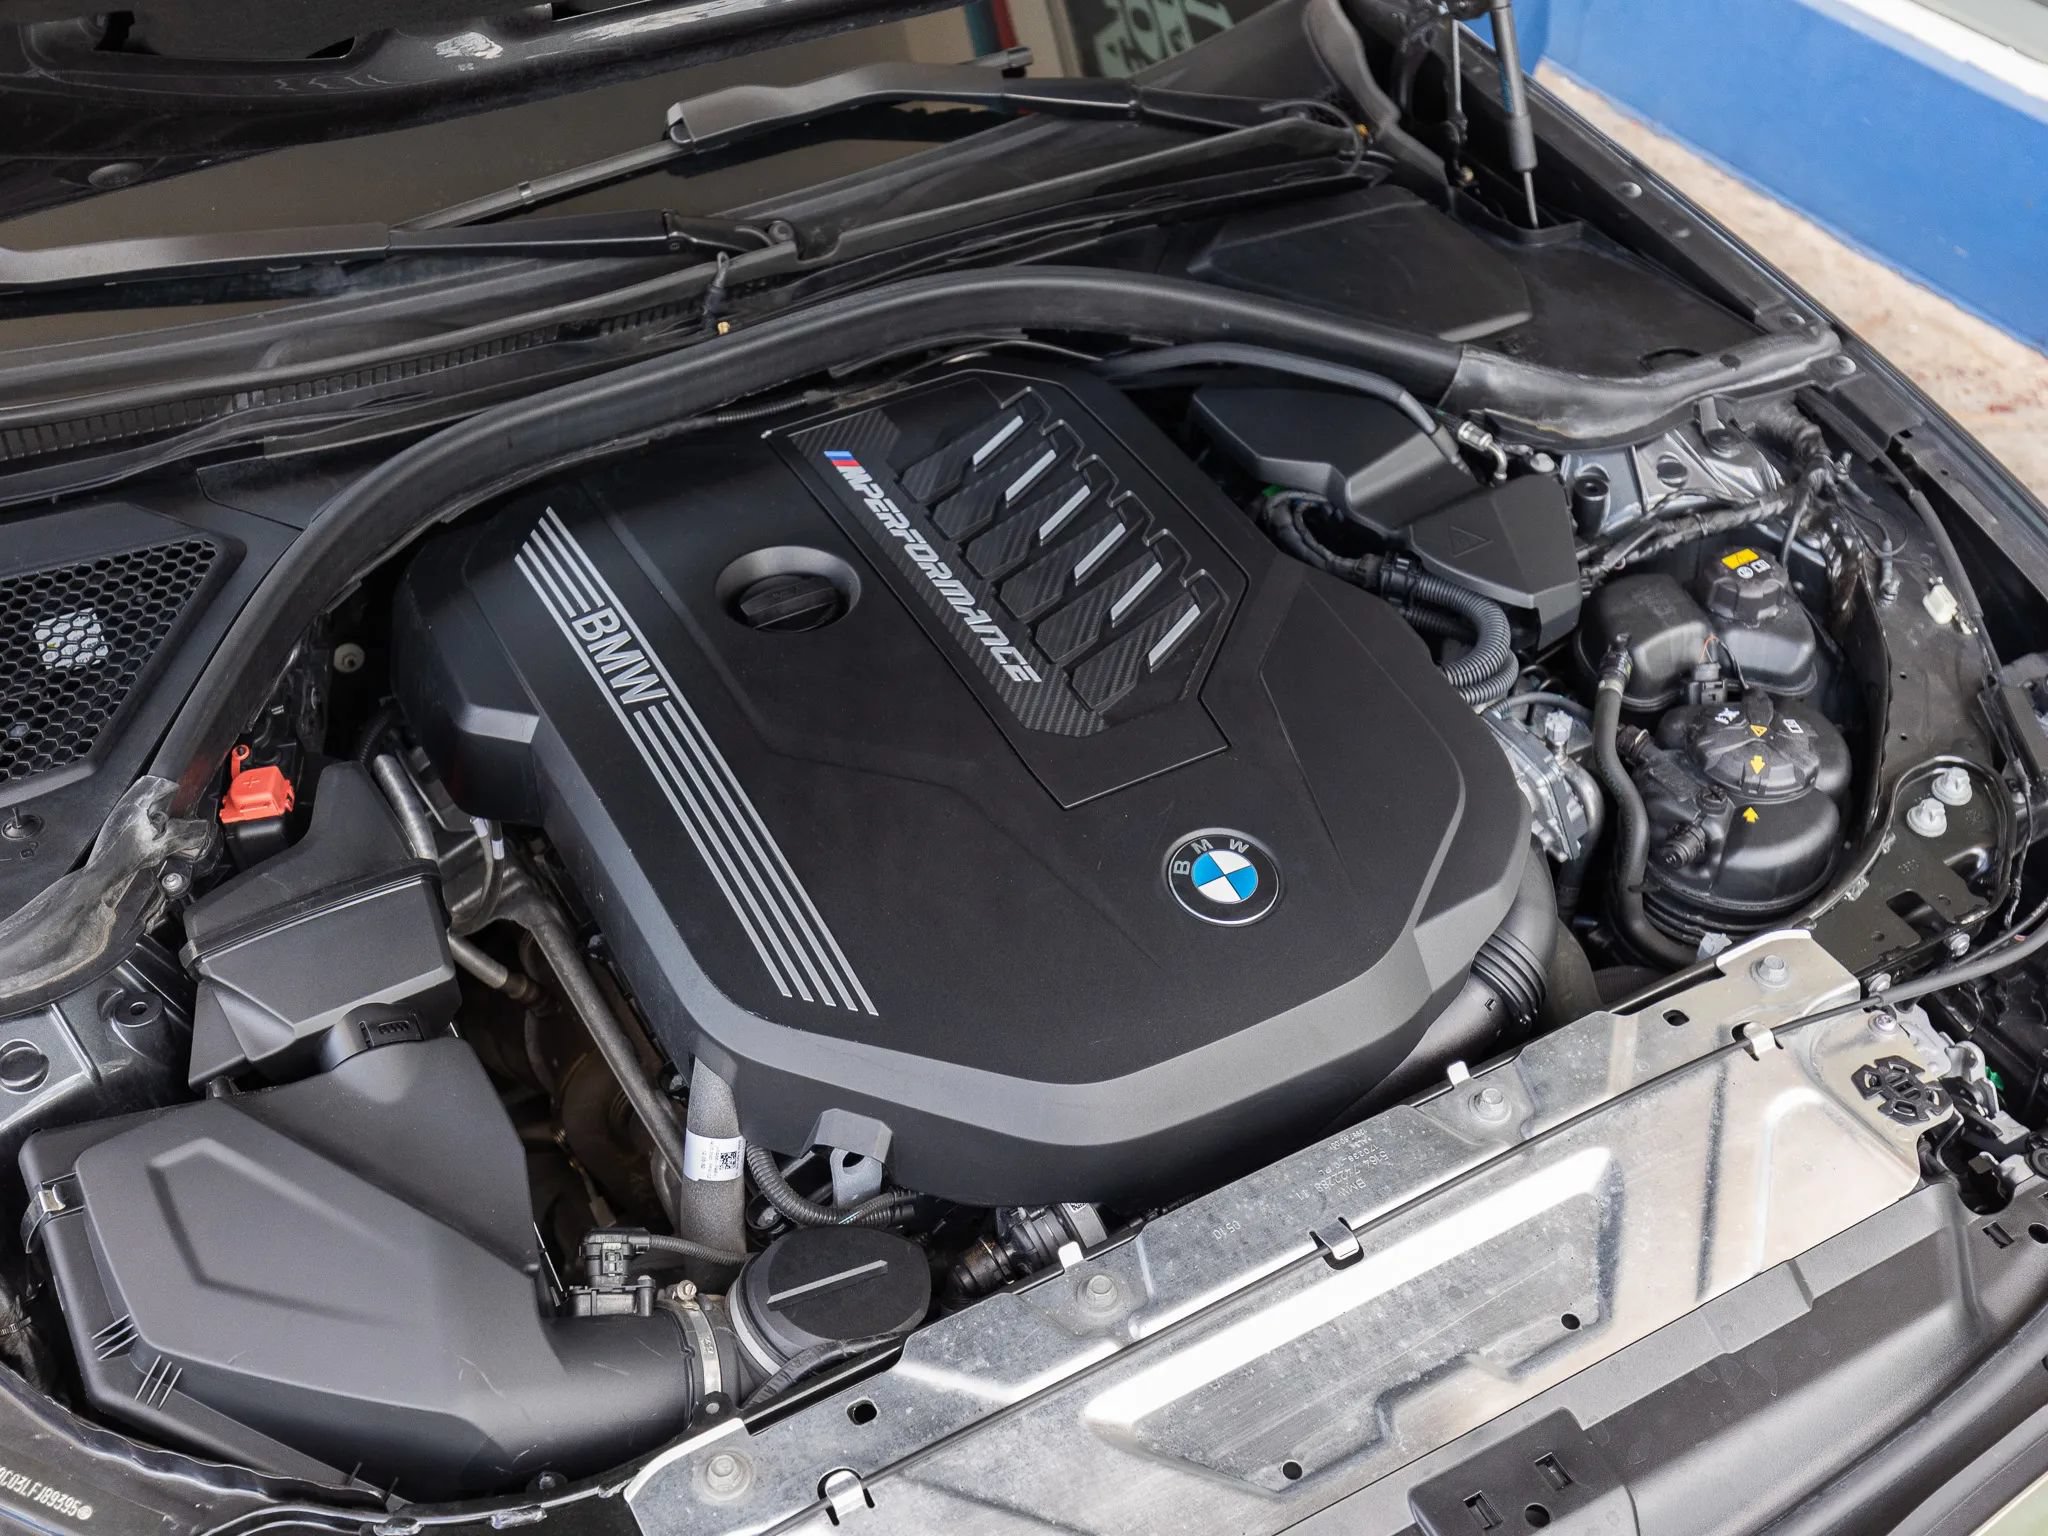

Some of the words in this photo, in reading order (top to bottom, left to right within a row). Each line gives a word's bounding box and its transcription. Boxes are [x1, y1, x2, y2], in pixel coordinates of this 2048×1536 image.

[571, 607, 669, 704] BMW
[1173, 838, 1250, 876] BMW
[1337, 1178, 1367, 1198] BMW
